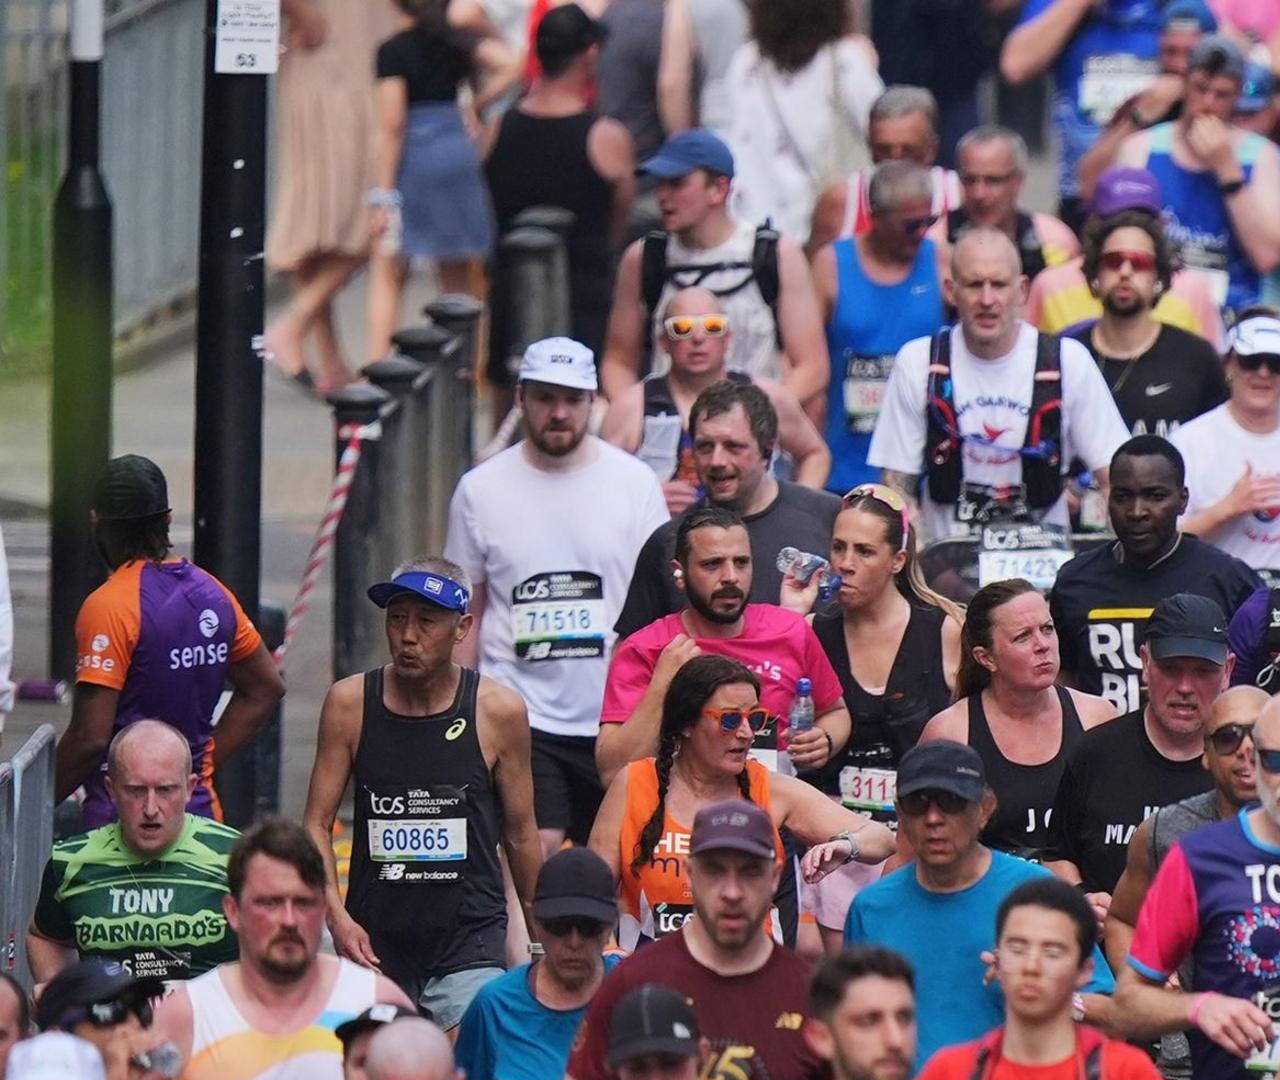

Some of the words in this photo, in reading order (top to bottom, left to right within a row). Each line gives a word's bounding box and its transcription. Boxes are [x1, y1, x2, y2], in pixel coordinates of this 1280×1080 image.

[526, 609, 591, 632] 71518
[170, 642, 228, 670] sense
[407, 790, 430, 799] TATA
[371, 791, 404, 815] tcs
[407, 798, 459, 807] CONSULTANCY
[407, 806, 441, 815] SERVICES
[382, 828, 449, 852] 60865
[405, 872, 423, 881] new
[424, 870, 458, 881] balance
[109, 888, 174, 915] TONY
[77, 915, 222, 946] BARNARDO'S
[135, 952, 156, 961] TATA
[135, 960, 184, 969] CONSULTANCY
[135, 968, 168, 977] SERVICES
